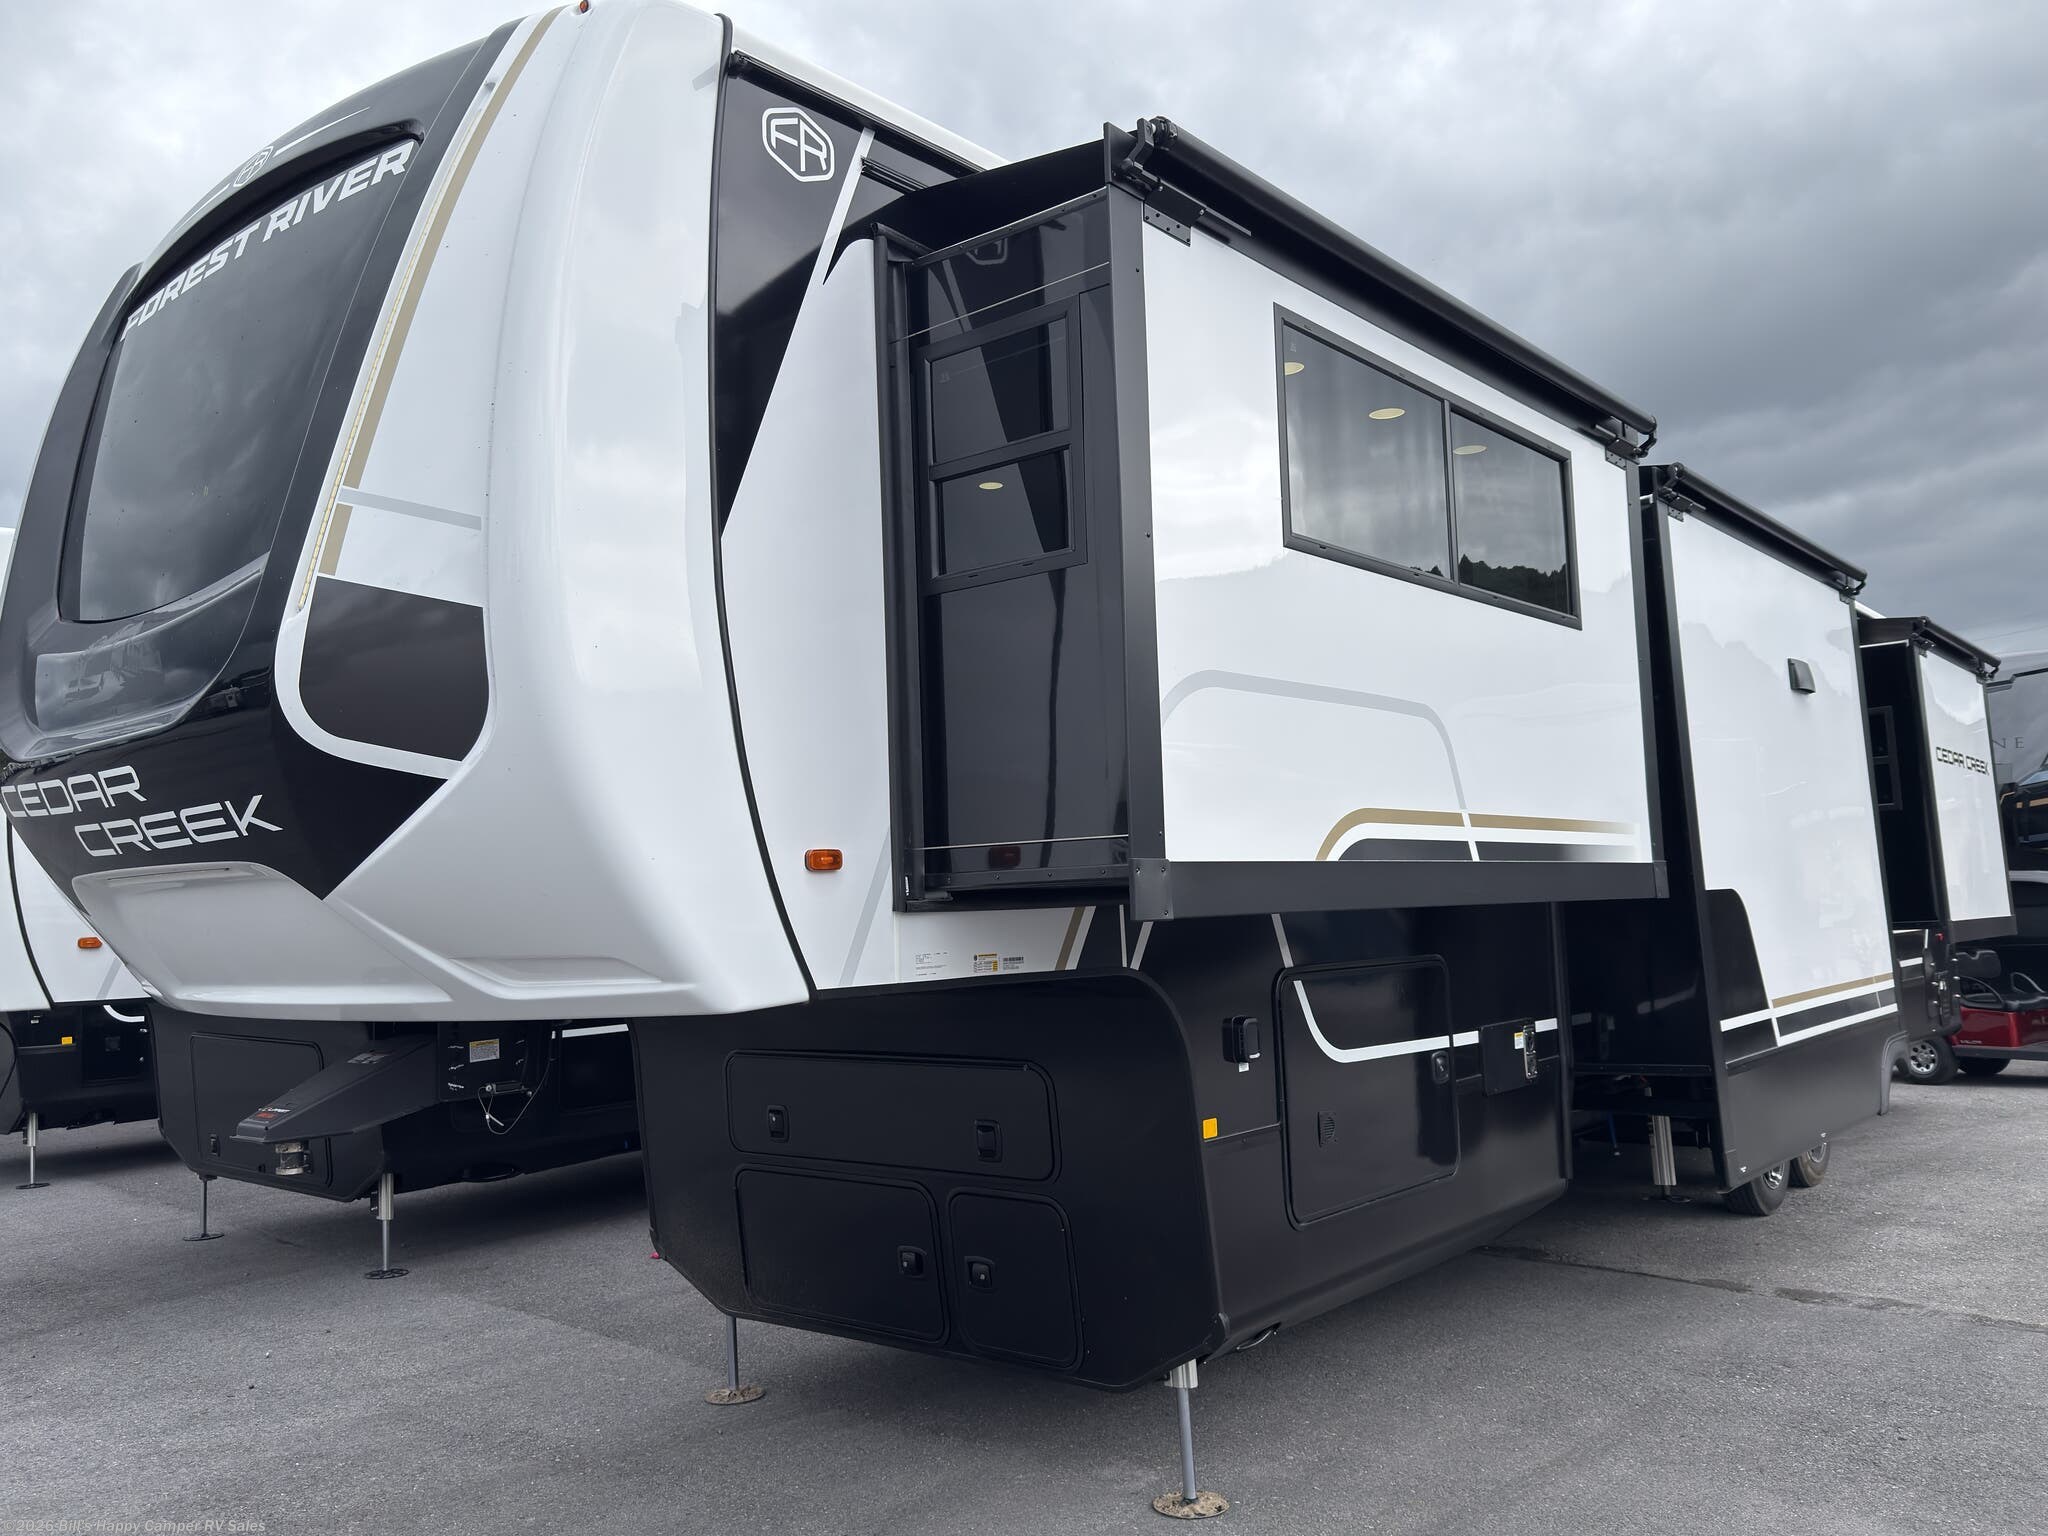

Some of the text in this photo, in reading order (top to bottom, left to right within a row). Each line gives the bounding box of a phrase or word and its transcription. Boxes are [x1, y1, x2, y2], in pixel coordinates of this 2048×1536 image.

[120, 140, 415, 342] FOREST RIVER
[1936, 746, 1989, 776] CEDAR CREEK
[1, 765, 284, 857] CEDAR CREEK
